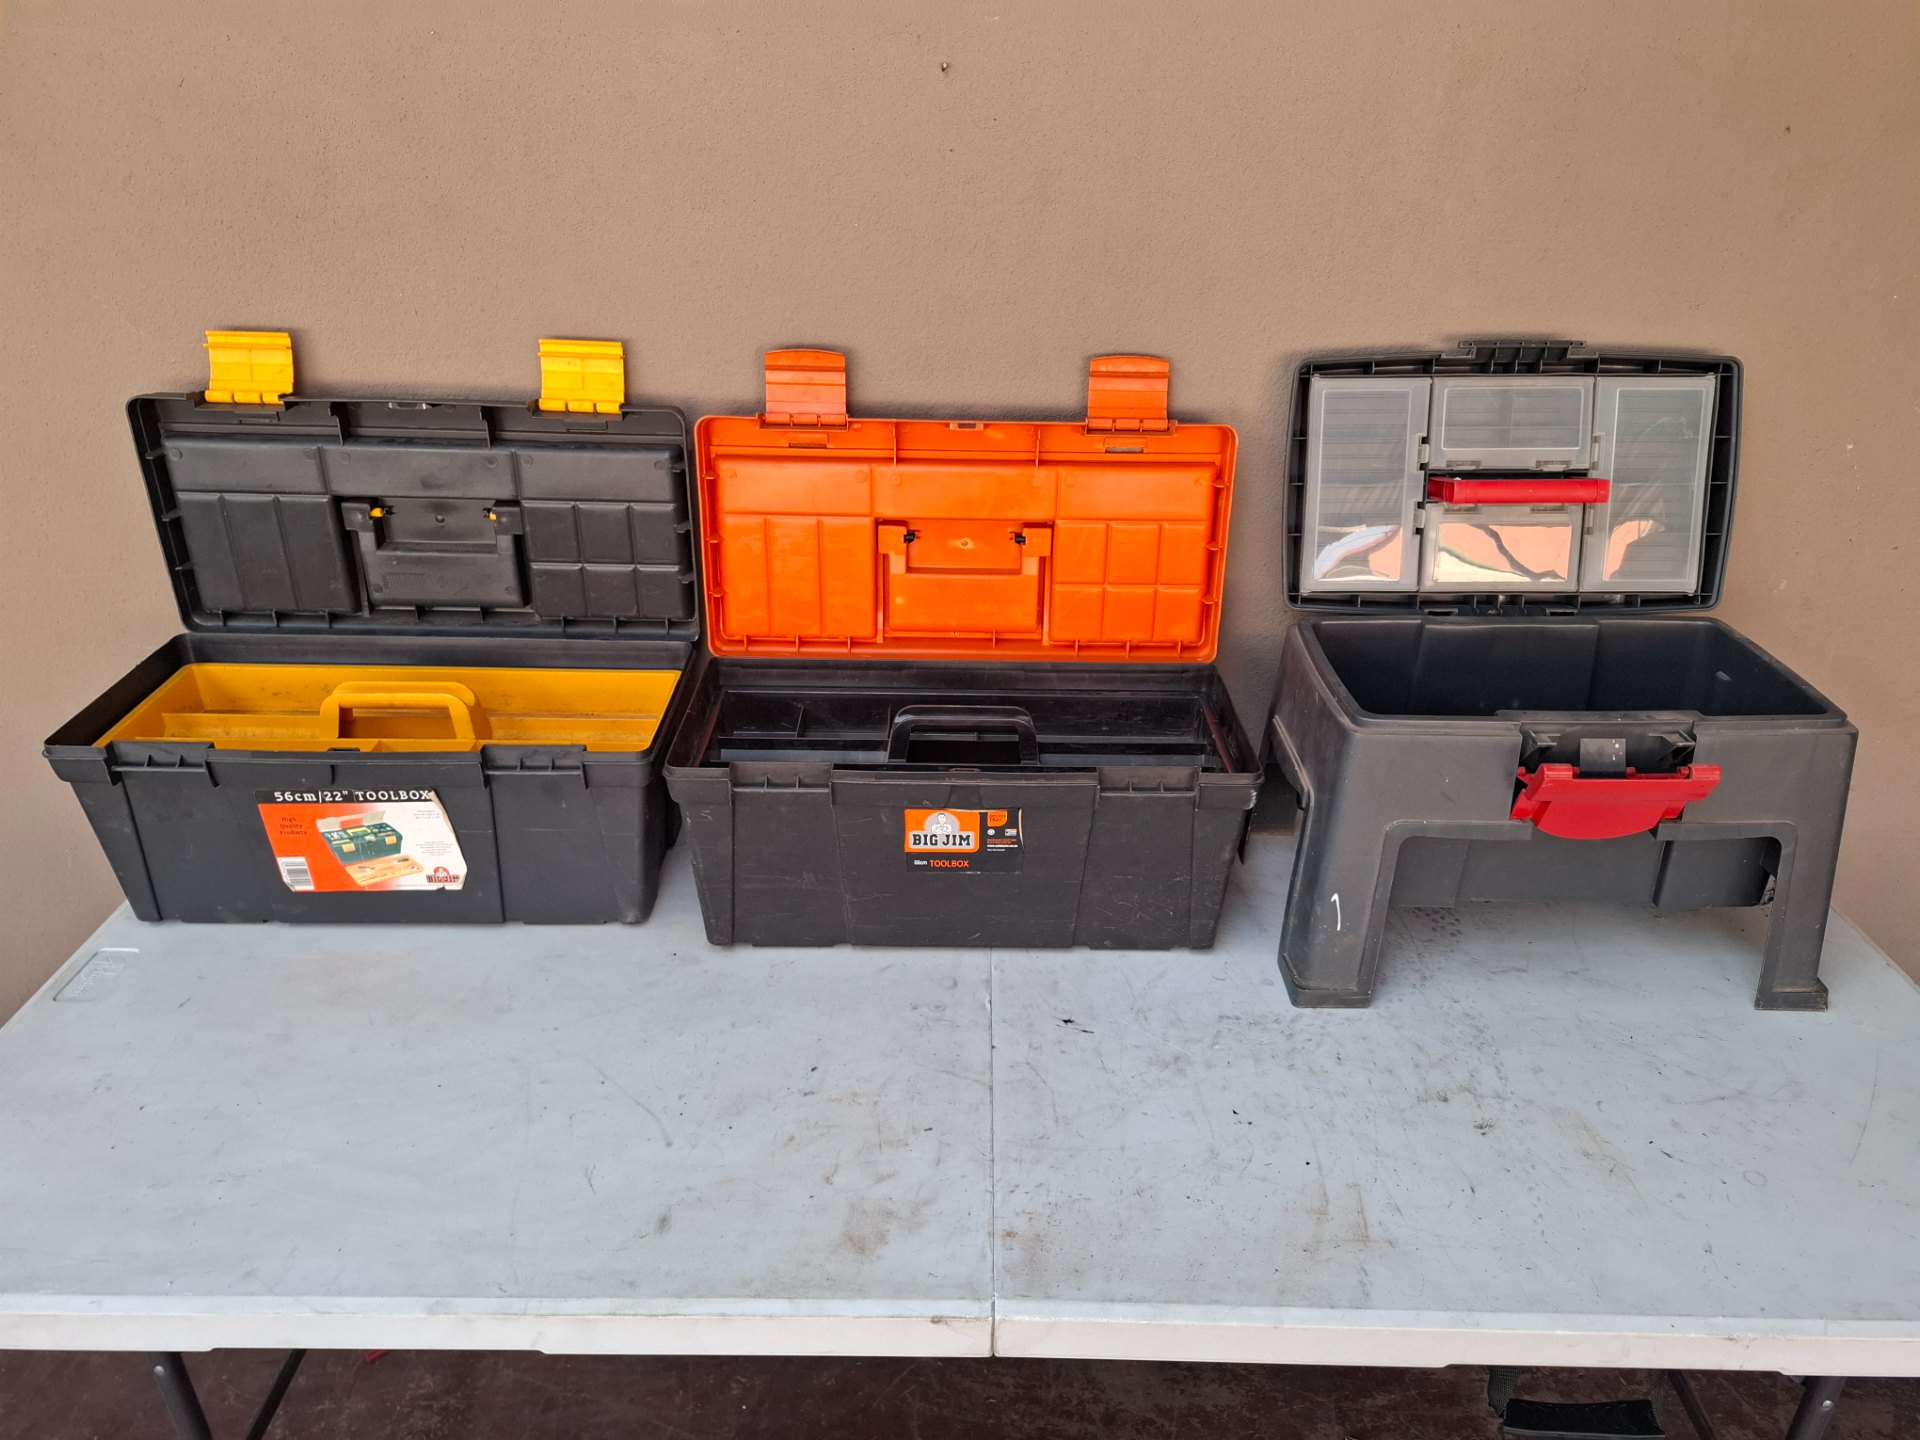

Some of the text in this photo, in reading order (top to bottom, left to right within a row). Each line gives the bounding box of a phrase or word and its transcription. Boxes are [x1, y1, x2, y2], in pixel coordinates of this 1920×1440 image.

[355, 789, 431, 801] TOOLBOX
[912, 834, 970, 846] BIG JIM
[930, 860, 969, 868] TOOLBOX
